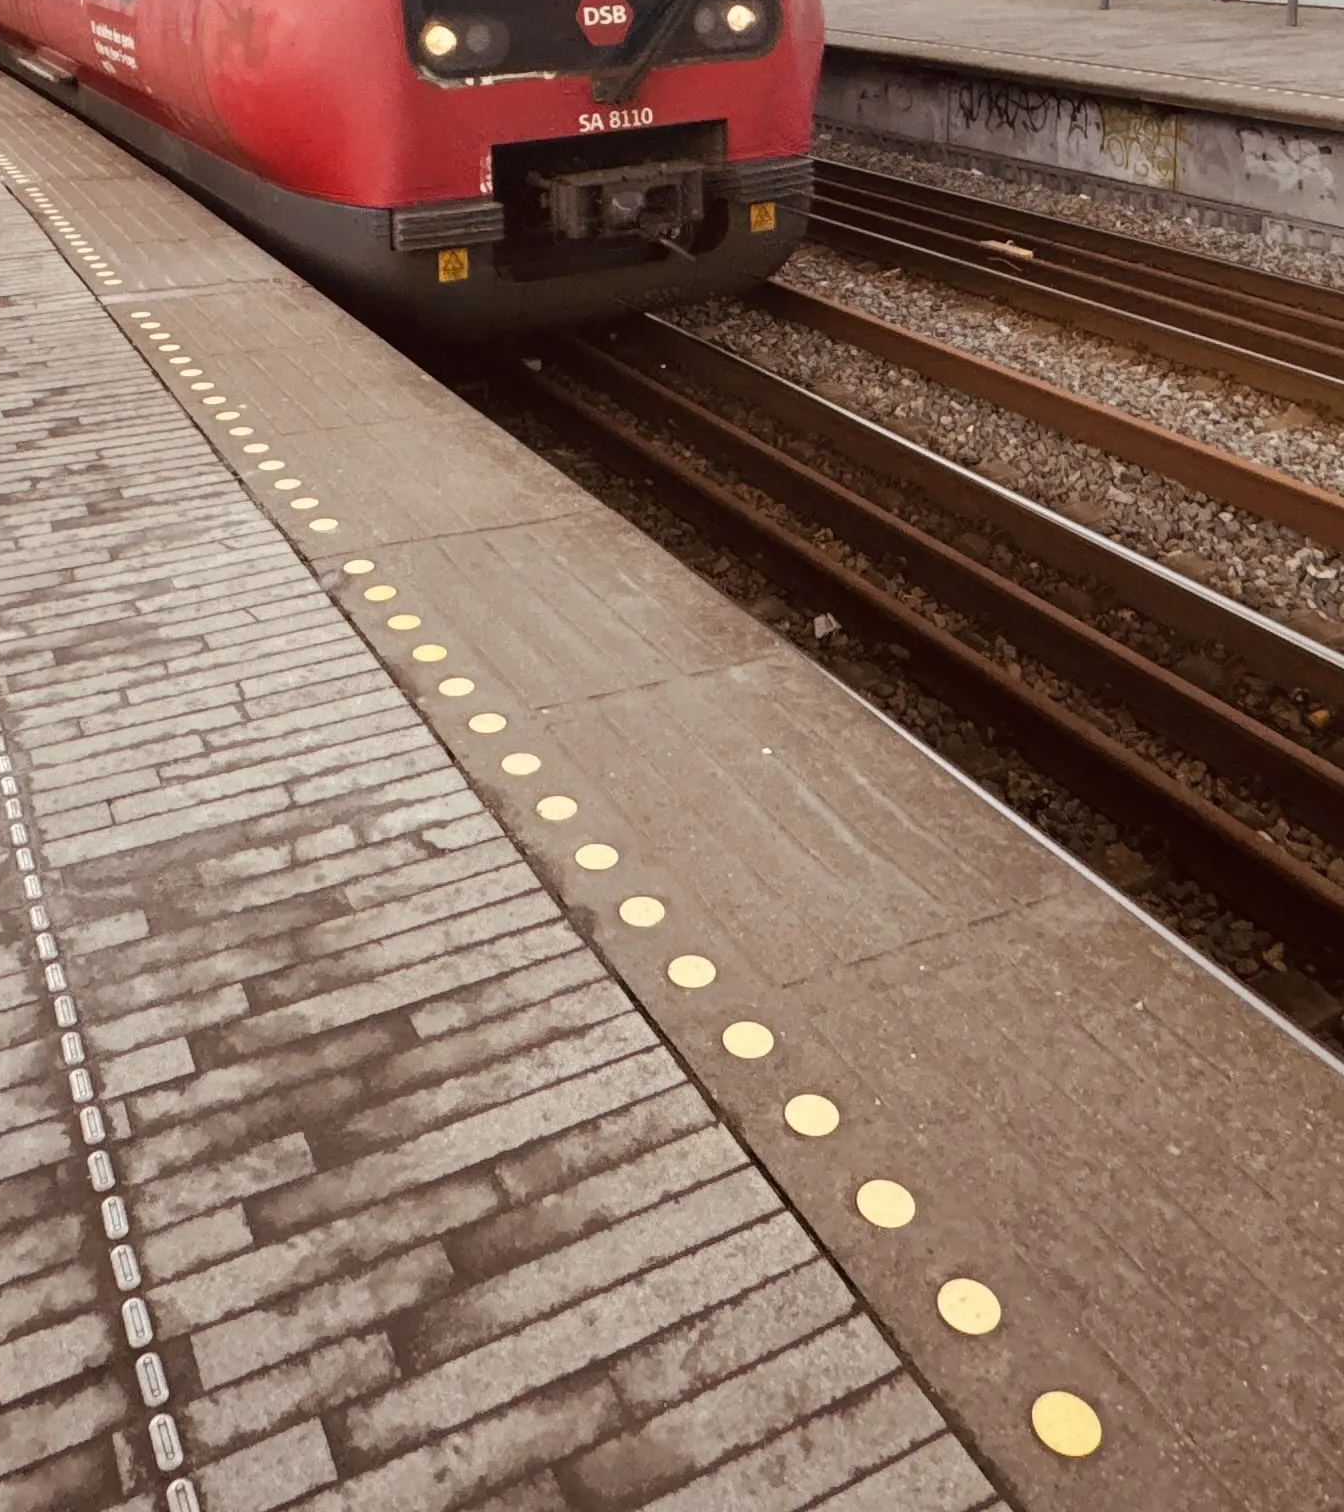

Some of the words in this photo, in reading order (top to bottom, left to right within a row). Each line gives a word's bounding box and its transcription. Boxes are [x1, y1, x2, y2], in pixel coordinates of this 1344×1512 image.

[583, 4, 627, 26] DSB
[578, 113, 604, 133] SA
[609, 107, 654, 129] 8110
